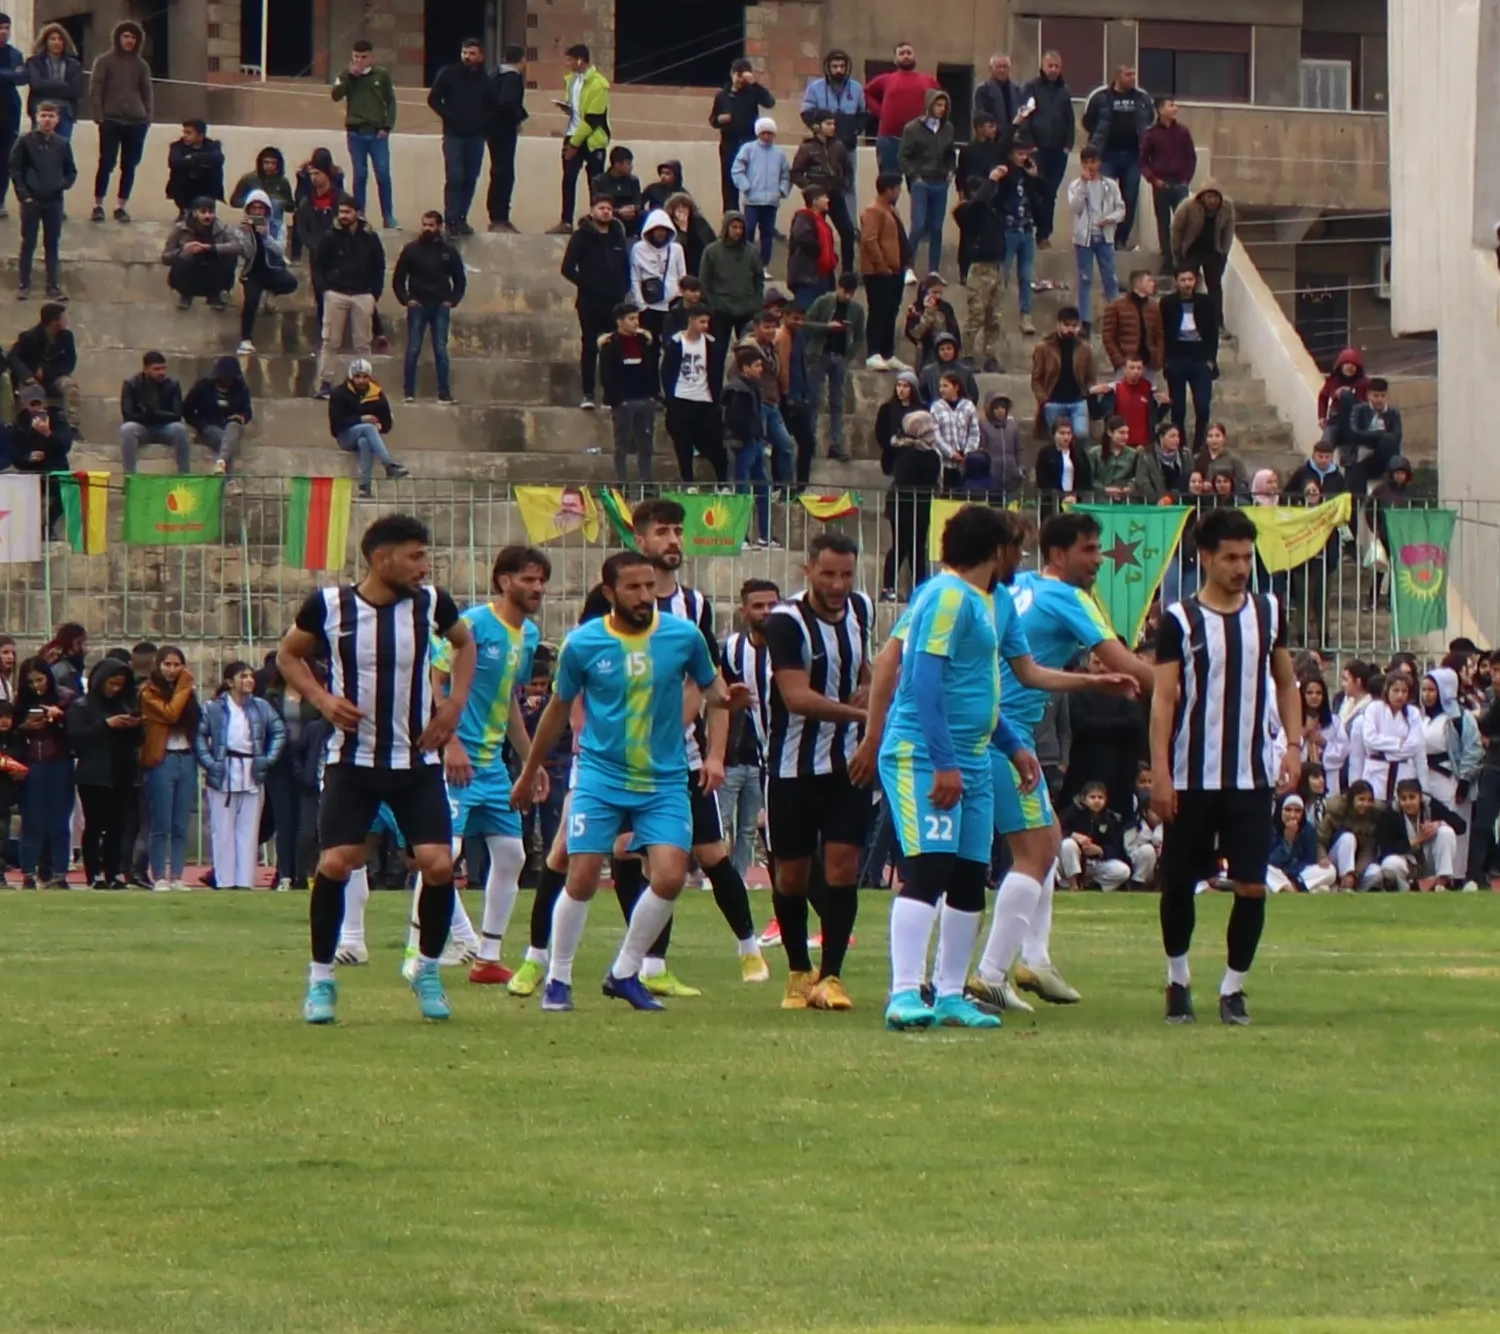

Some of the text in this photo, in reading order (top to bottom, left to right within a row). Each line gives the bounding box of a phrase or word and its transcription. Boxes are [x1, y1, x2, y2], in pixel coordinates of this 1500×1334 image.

[507, 644, 520, 668] 5
[625, 651, 648, 677] 15
[569, 812, 588, 839] 15
[923, 814, 954, 843] 22
